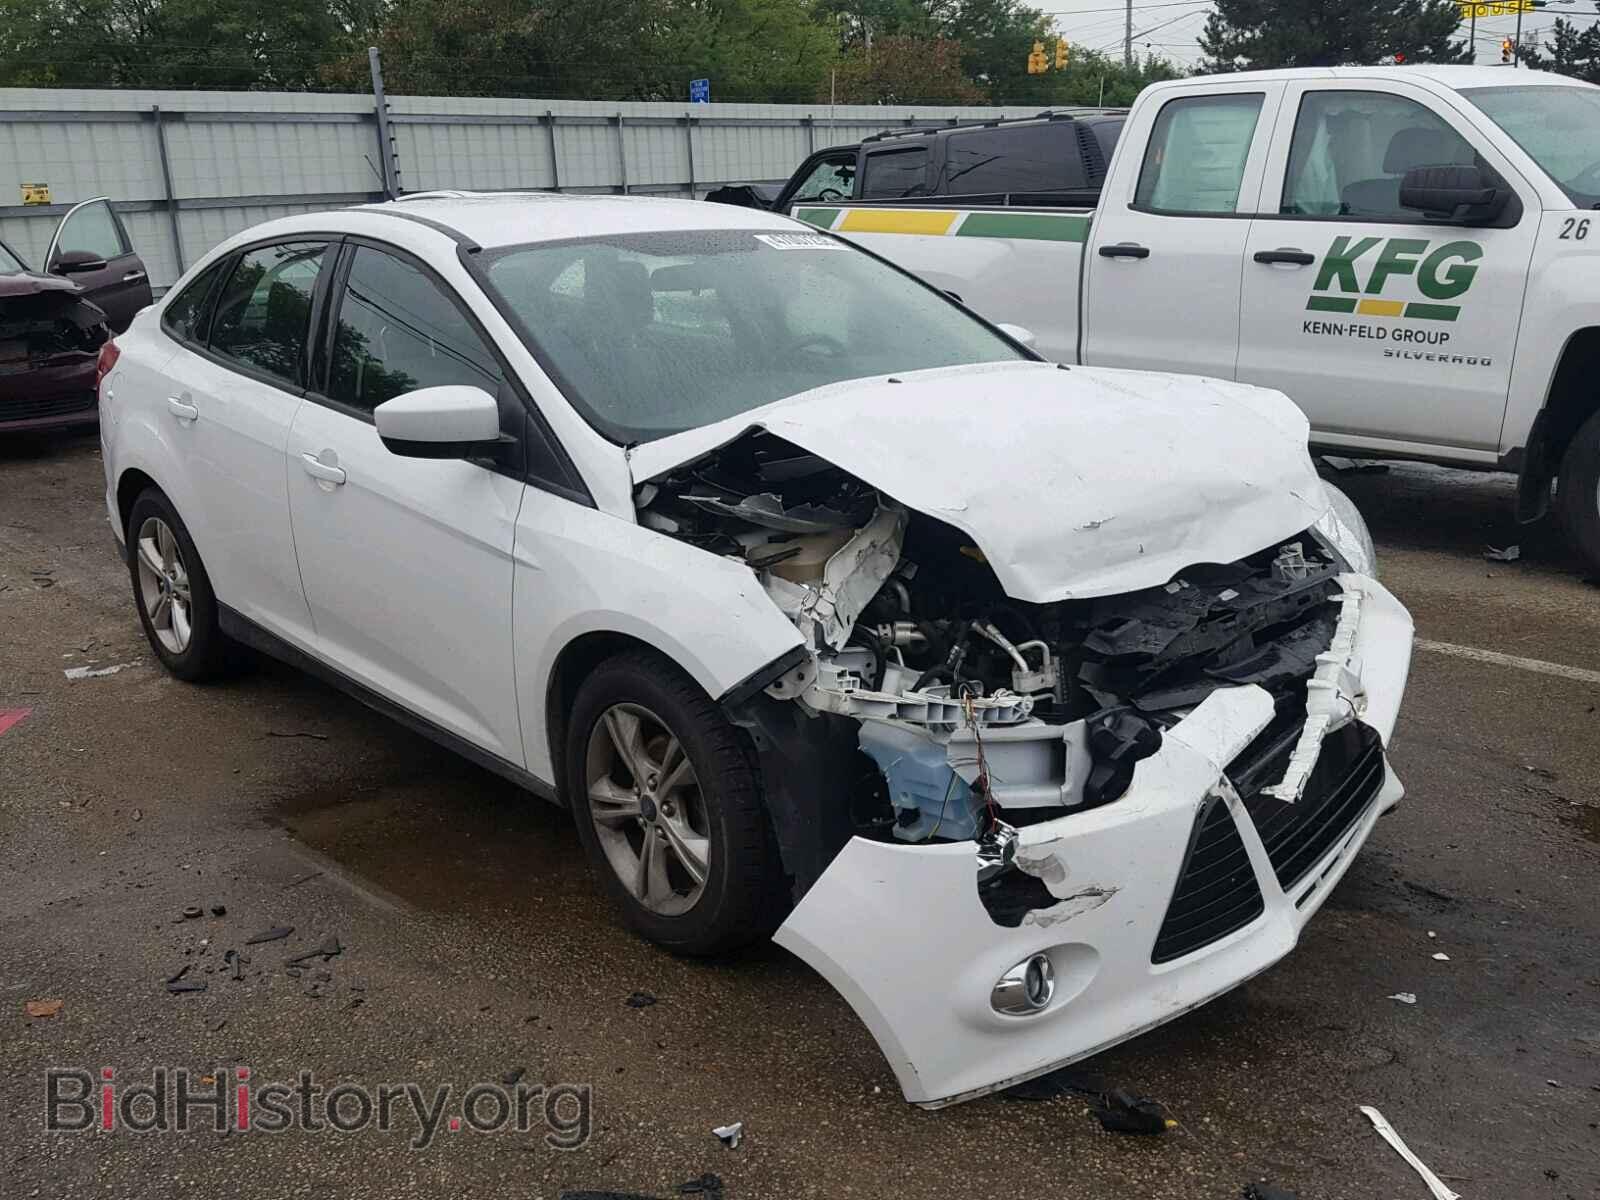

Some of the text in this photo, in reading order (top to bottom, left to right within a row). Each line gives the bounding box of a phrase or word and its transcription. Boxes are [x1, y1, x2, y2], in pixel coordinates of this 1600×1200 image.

[1559, 217, 1590, 240] 26
[1312, 235, 1484, 300] KFG
[1303, 321, 1450, 345] KENN-FELD GROUP
[1383, 348, 1493, 367] SILVERADO
